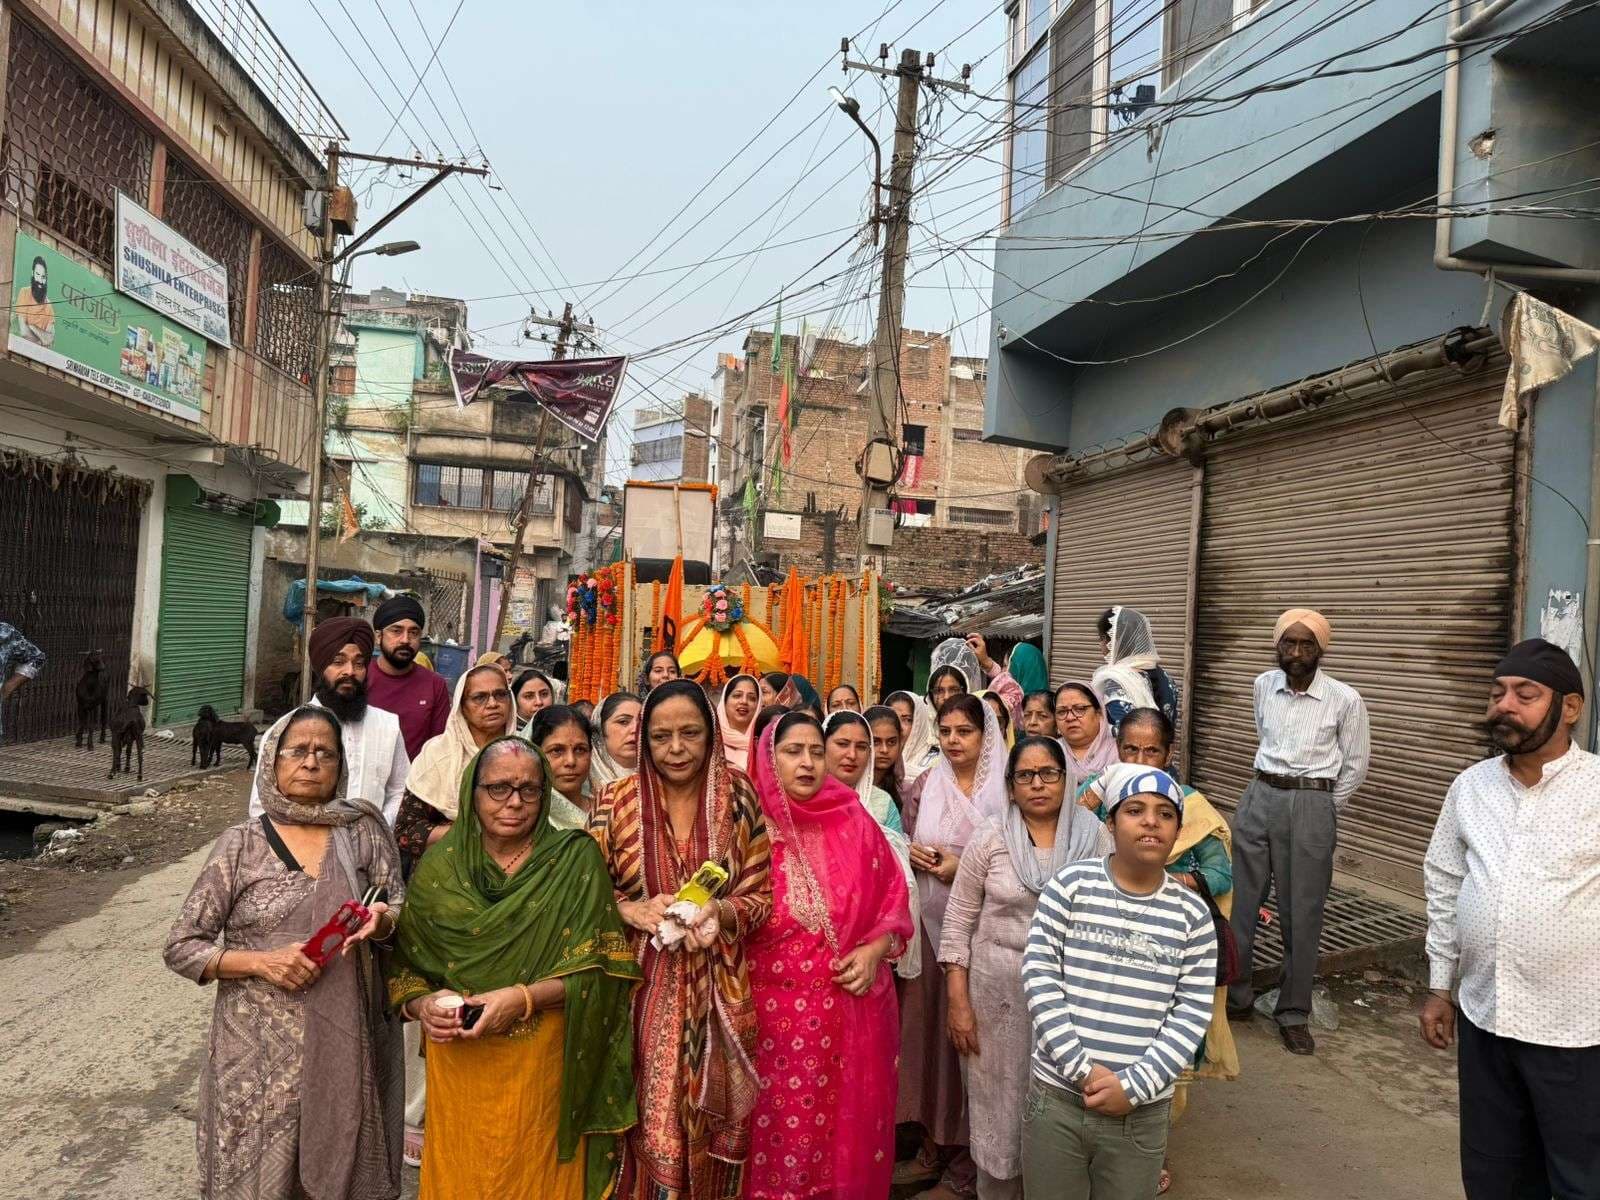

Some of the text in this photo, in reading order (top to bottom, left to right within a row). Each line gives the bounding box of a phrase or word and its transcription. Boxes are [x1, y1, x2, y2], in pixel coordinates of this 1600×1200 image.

[61, 282, 118, 327] पतंजलि
[123, 246, 173, 287] SHUSHILA
[174, 278, 227, 319] ENTERPRISES
